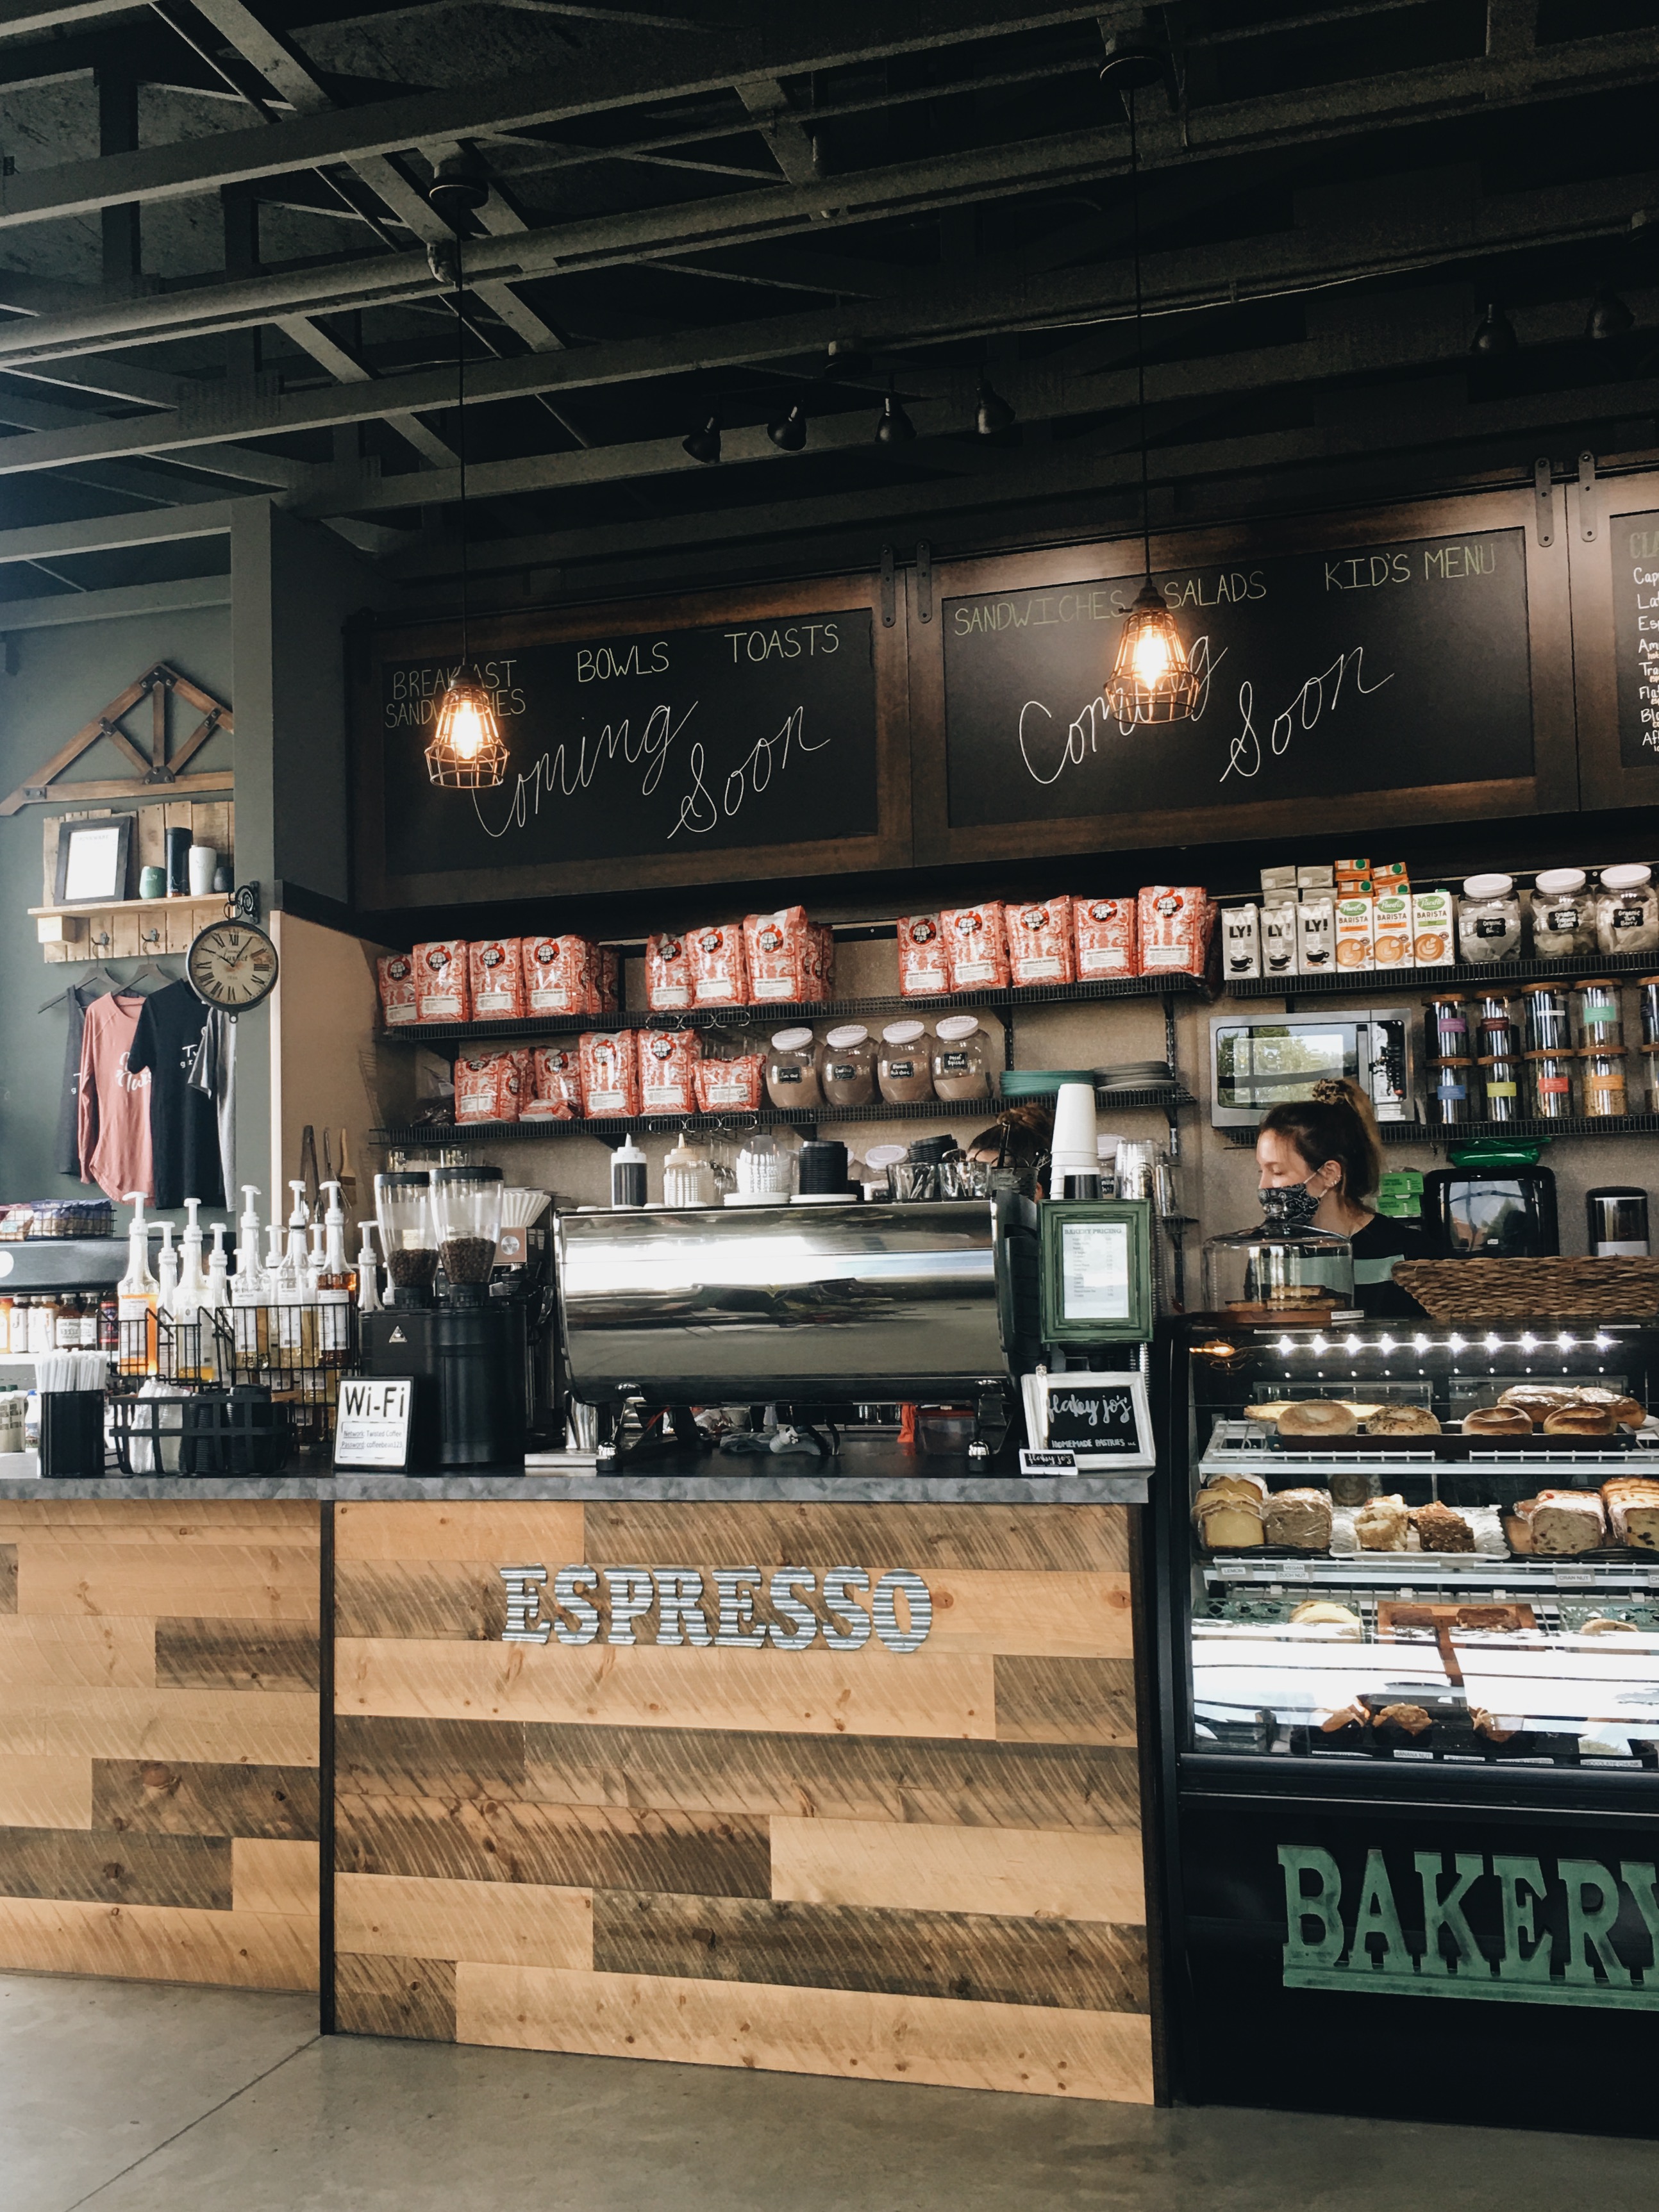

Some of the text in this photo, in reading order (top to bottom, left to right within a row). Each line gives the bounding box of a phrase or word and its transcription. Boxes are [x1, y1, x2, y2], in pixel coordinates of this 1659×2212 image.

[1324, 543, 1497, 592] KID'S MENU
[953, 570, 1267, 636] SANDWICHES SALADS
[576, 642, 670, 683] BOWLS
[724, 623, 839, 663] TOASTS
[394, 660, 517, 700] BREAKAST
[385, 688, 526, 728] SANDHES
[1219, 646, 1395, 783] Soon
[667, 706, 831, 839] Soon
[1229, 924, 1252, 938] LY!
[1305, 919, 1328, 933] LY!
[1417, 910, 1447, 919] BARISTA
[345, 1386, 404, 1417] Wi-Fi
[1046, 1394, 1132, 1426] flakey jo's
[1052, 1440, 1093, 1449] HOMEMADE
[1095, 1438, 1125, 1447] PASTRIES
[499, 1563, 933, 1654] ESPRESSO
